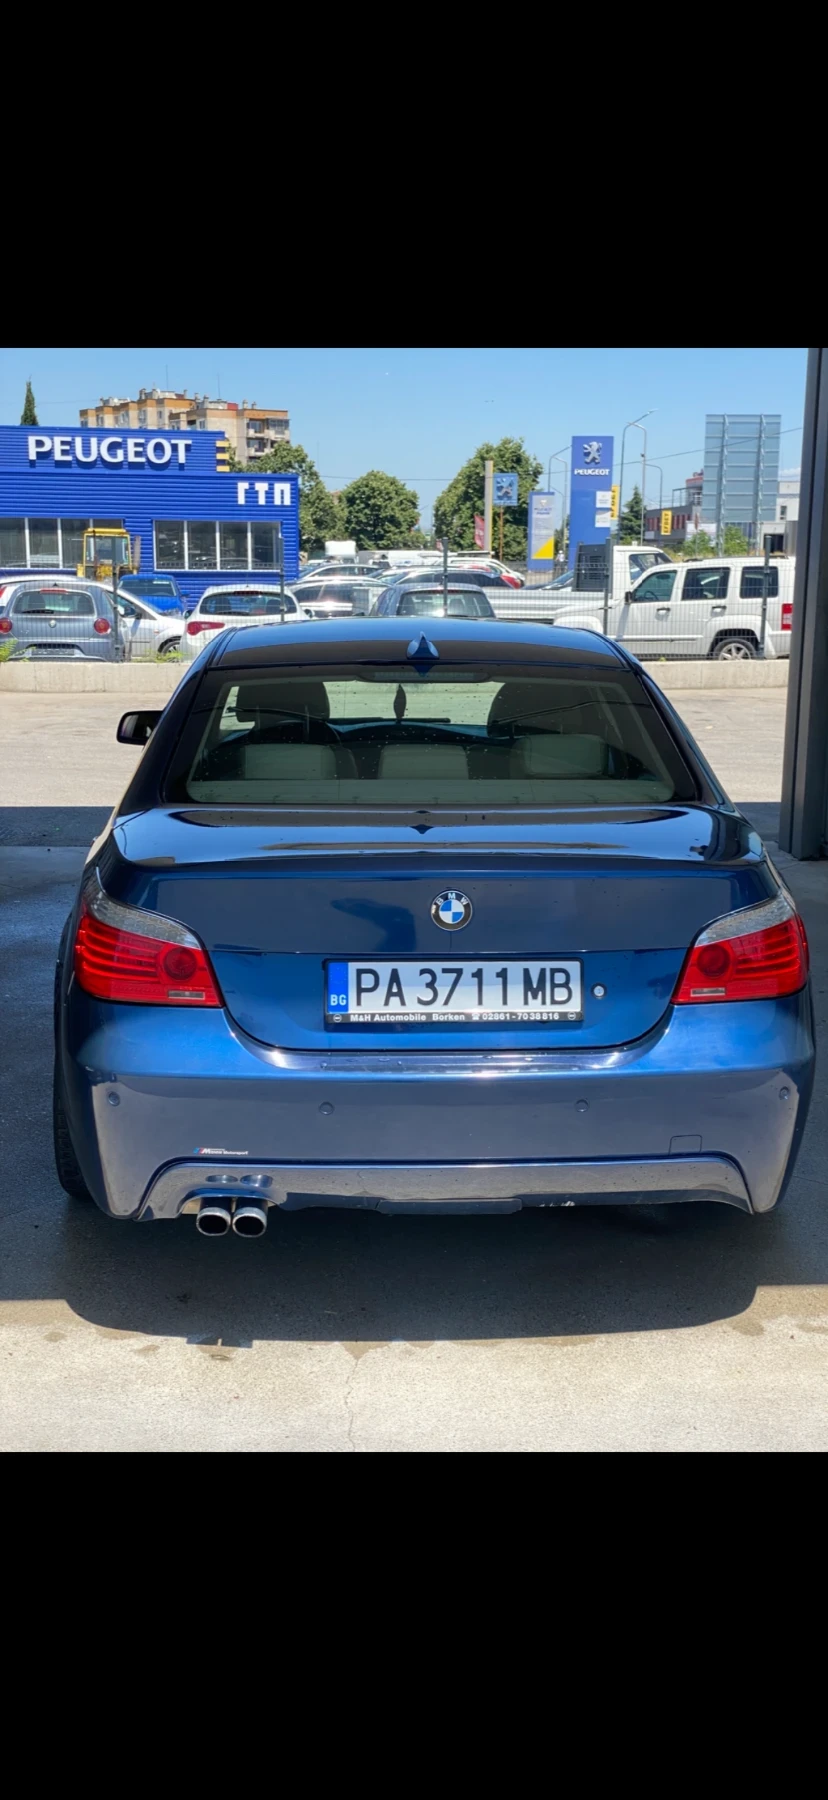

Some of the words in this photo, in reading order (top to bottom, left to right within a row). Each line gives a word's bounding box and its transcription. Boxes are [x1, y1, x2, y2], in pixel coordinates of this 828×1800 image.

[28, 435, 192, 464] PEUGEOT
[237, 482, 291, 505] ГТП
[436, 892, 469, 906] BMW
[330, 994, 347, 1006] BG
[350, 1014, 374, 1022] M&H
[374, 1013, 426, 1022] Automobile
[432, 1013, 465, 1021] Borken
